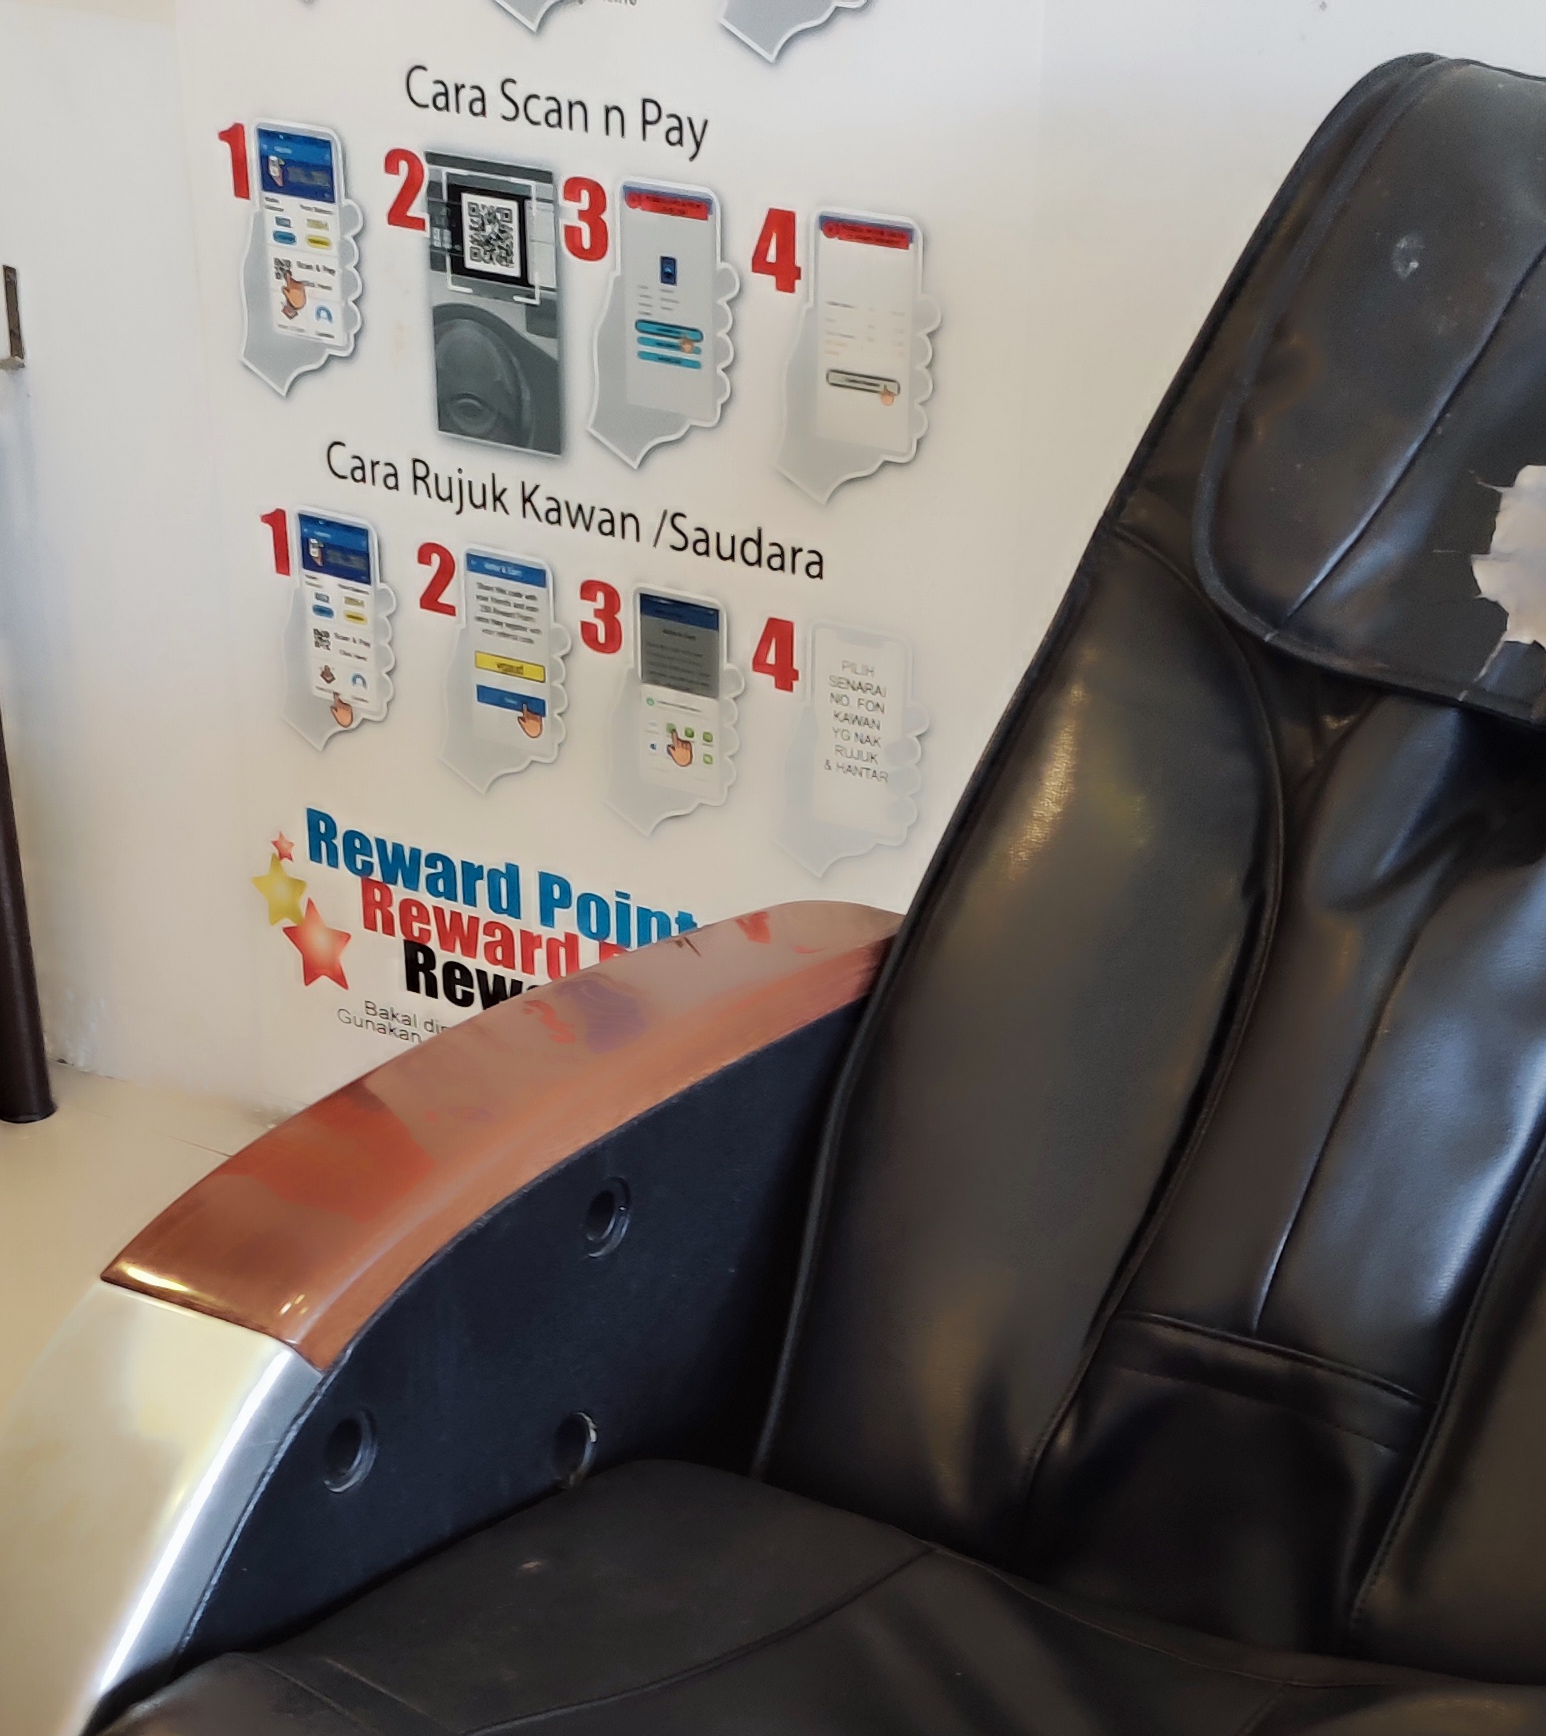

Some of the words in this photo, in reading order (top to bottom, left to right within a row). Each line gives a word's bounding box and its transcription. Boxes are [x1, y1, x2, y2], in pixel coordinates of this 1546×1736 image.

[405, 65, 487, 118] Cara
[500, 78, 589, 133] Scan
[604, 104, 626, 138] n
[640, 98, 709, 162] Pay
[217, 123, 251, 200] 1
[383, 148, 427, 231] 2
[563, 176, 609, 262] 3
[751, 208, 802, 294] 4
[259, 508, 291, 576] 1
[326, 441, 400, 492] Cara
[411, 458, 510, 515] Rujuk
[520, 480, 641, 543] Kawan
[652, 509, 826, 580] /Saudara
[416, 541, 457, 617] 2
[579, 579, 623, 654] 3
[752, 617, 799, 693] 4
[829, 674, 886, 697] SENARAI
[832, 727, 851, 741] YG
[854, 732, 882, 748] NAK
[833, 710, 881, 731] KAWAN
[857, 698, 885, 715] FON
[834, 744, 879, 764] RUJUK
[836, 761, 889, 783] HANTAR
[305, 808, 522, 920] Reward
[359, 876, 580, 981] Reward
[402, 938, 540, 1010] Rew
[337, 1008, 423, 1044] Gunakan
[364, 1000, 418, 1029] Bakal
